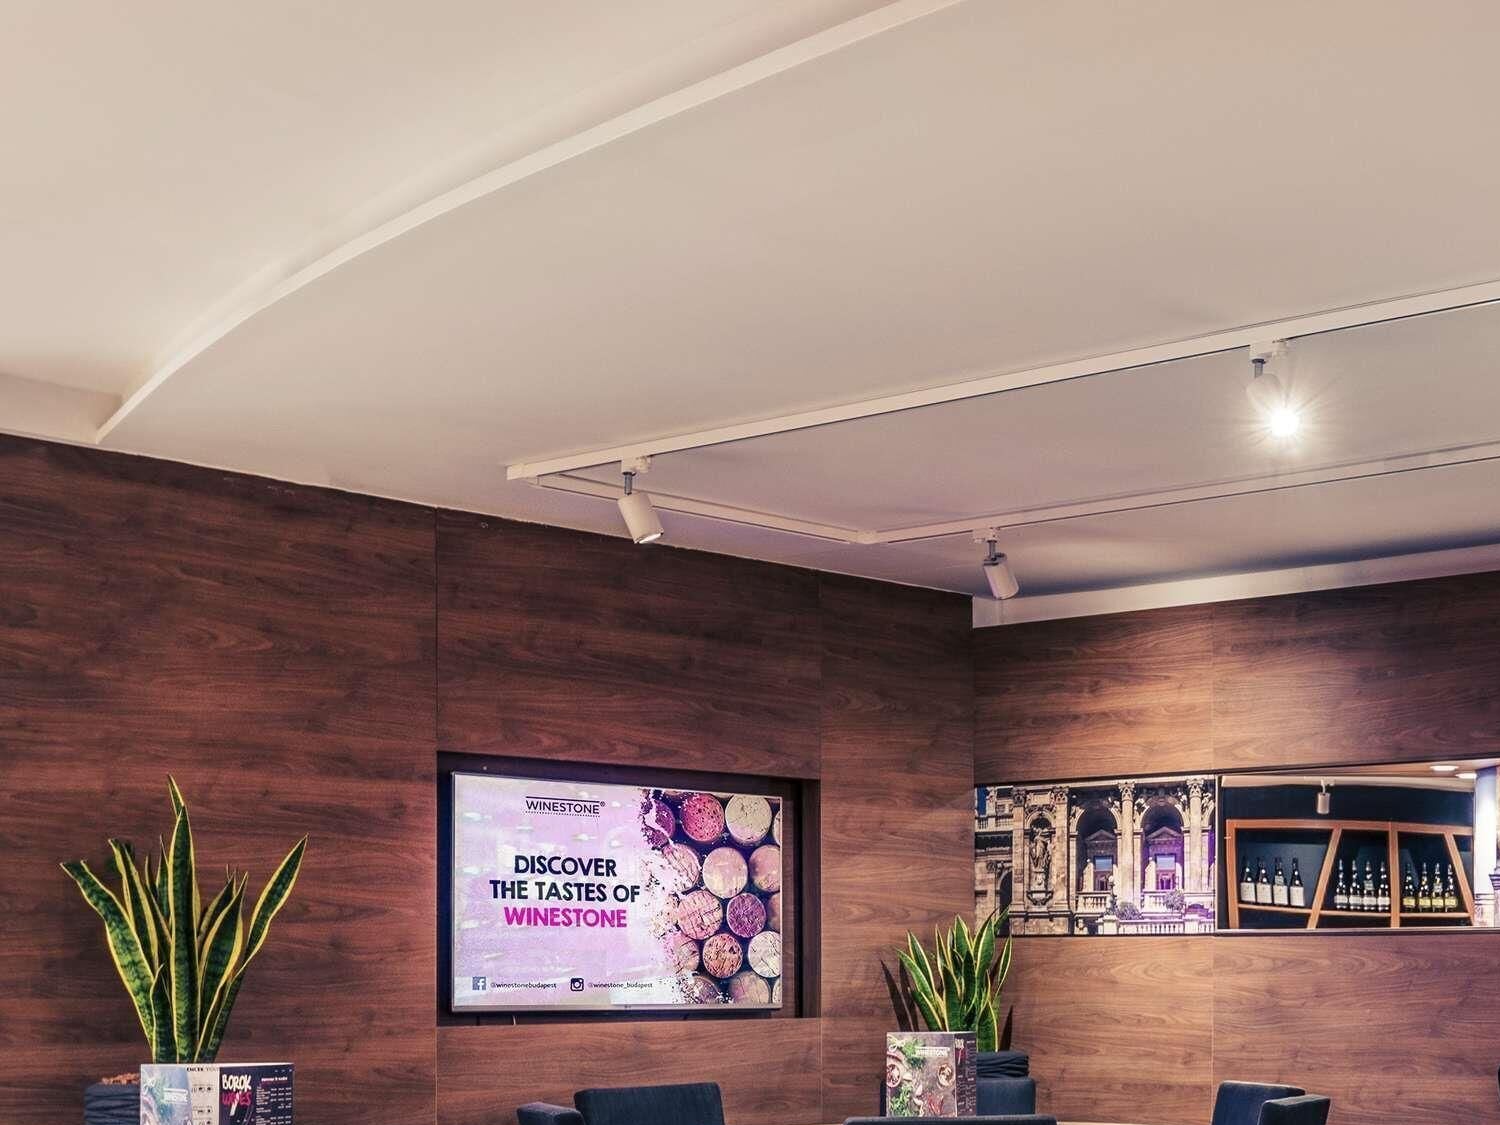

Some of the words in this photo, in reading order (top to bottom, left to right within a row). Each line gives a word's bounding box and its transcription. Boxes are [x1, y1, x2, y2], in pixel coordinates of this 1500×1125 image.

[514, 855, 617, 877] DISCOVER
[489, 879, 528, 899] THE
[535, 881, 607, 902] TASTES
[613, 884, 641, 903] OF
[504, 906, 627, 928] WINESTONE
[490, 981, 557, 989] @winestonebudapest
[222, 1074, 252, 1092] BOROK
